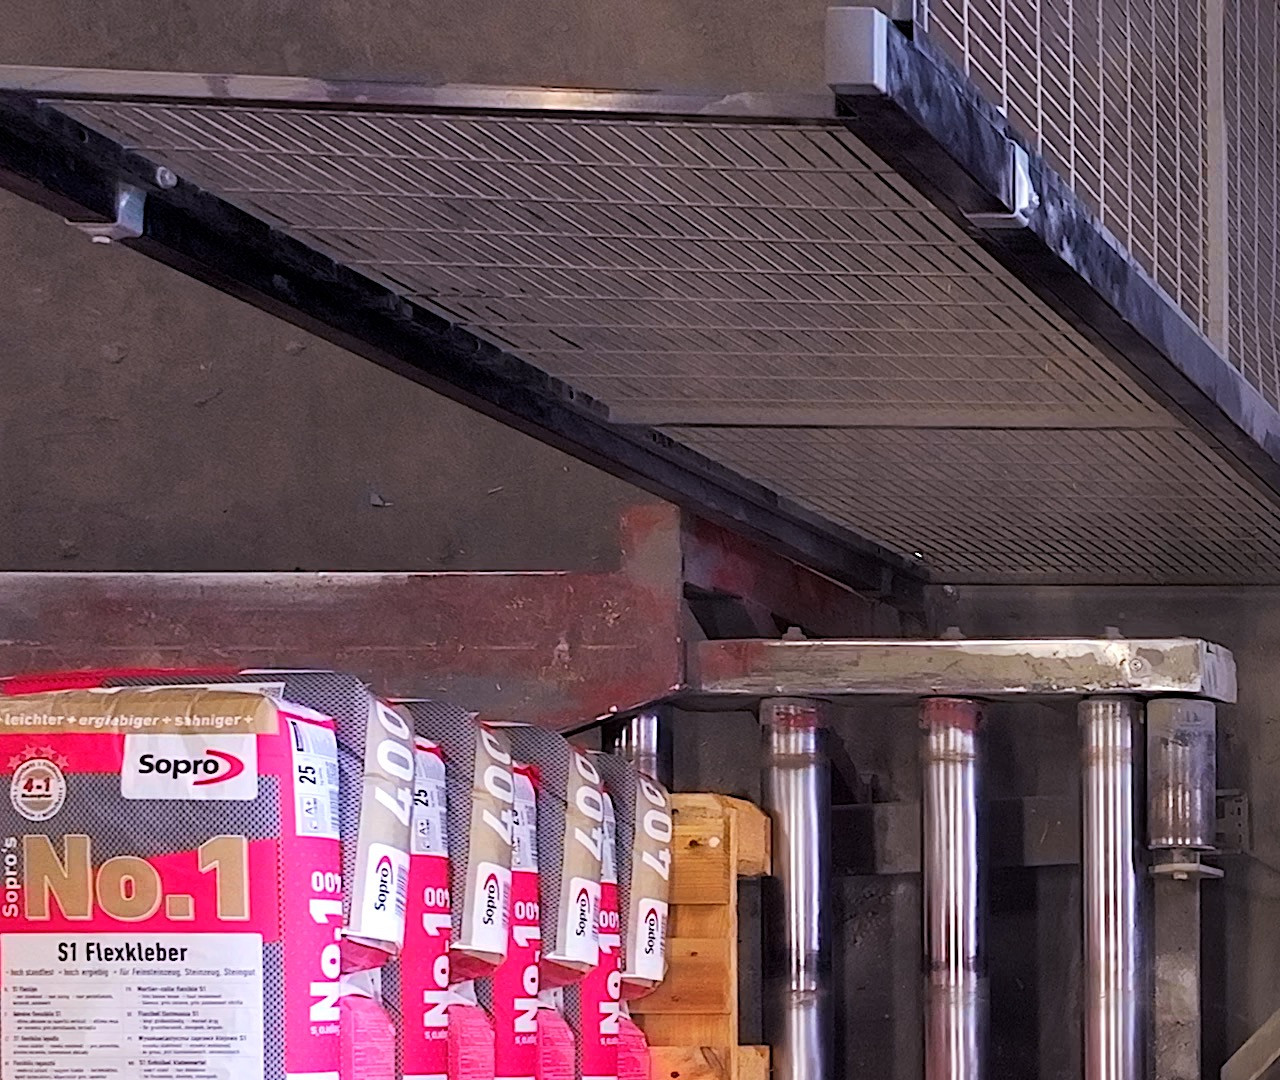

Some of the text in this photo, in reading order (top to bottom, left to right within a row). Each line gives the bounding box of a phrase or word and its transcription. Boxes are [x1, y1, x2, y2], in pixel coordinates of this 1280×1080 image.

[5, 715, 64, 726] leichter
[138, 754, 219, 779] Sopro
[299, 765, 316, 785] 25
[375, 700, 415, 827] 400
[481, 724, 514, 845] 400
[23, 778, 51, 792] 4 1
[414, 789, 428, 807] 25
[575, 753, 603, 861] 400
[640, 775, 673, 881] 400
[2, 837, 18, 917] Sopro's
[23, 834, 249, 921] No.1
[374, 867, 390, 911] Sopro
[483, 884, 497, 926] Sopro
[576, 898, 587, 937] Sopro
[58, 942, 188, 962] S1 Flexkleber
[645, 913, 656, 955] Sopro
